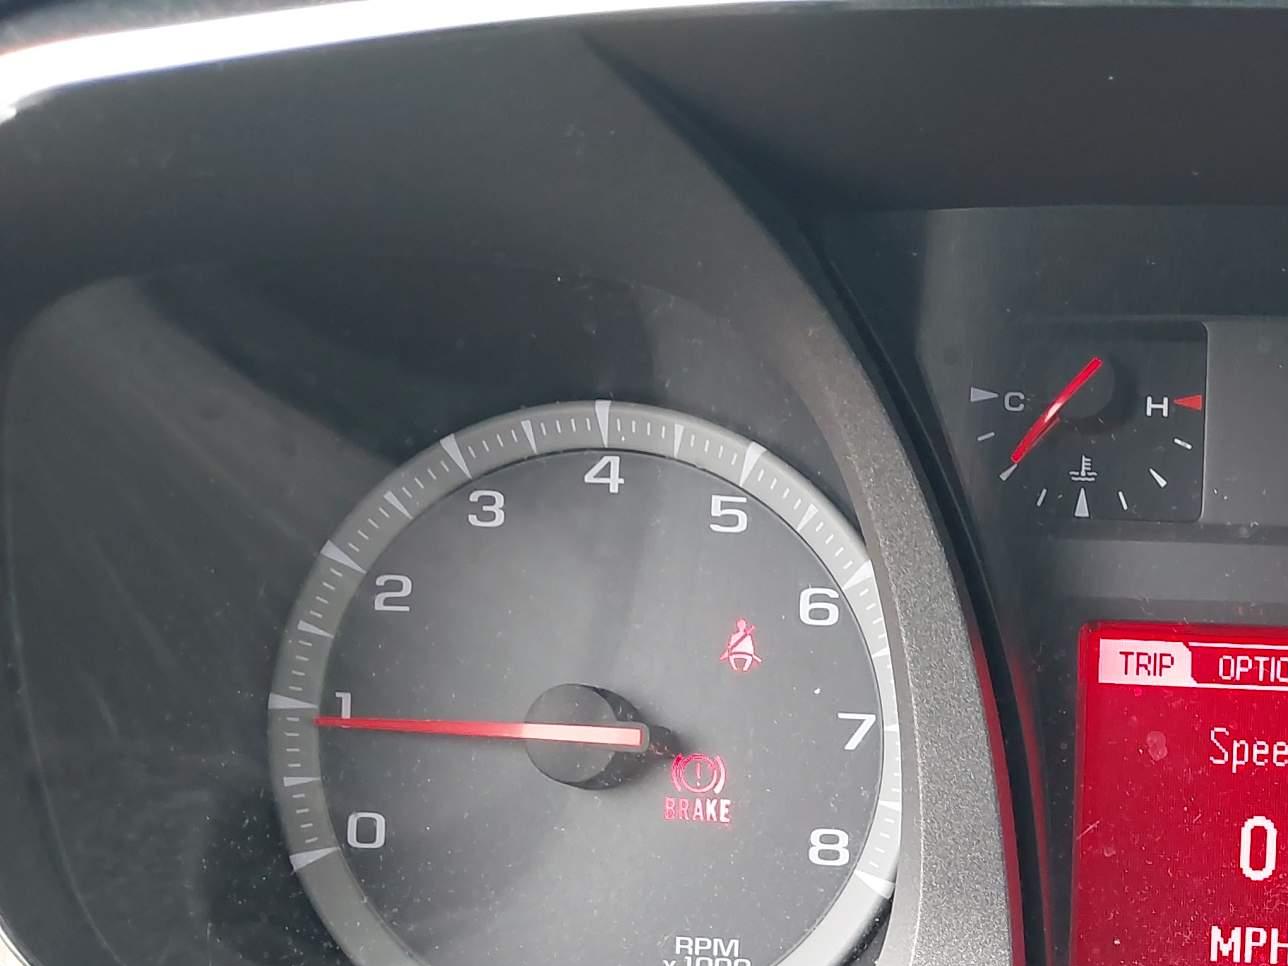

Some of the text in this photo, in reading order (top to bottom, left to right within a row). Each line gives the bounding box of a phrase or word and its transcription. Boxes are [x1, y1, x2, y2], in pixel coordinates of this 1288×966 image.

[1004, 391, 1025, 412] C
[1146, 397, 1168, 418] H
[584, 455, 624, 493] 4
[467, 490, 506, 528] 3
[710, 495, 748, 533] 5
[374, 574, 413, 612] 2
[800, 588, 839, 626] 6
[1119, 651, 1175, 677] TRIP
[335, 691, 352, 727] 1
[837, 712, 876, 751] 7
[664, 798, 731, 823] BRAKE
[347, 811, 386, 850] 0
[808, 828, 849, 866] 8
[1239, 815, 1278, 881] 0
[675, 936, 739, 958] RPM
